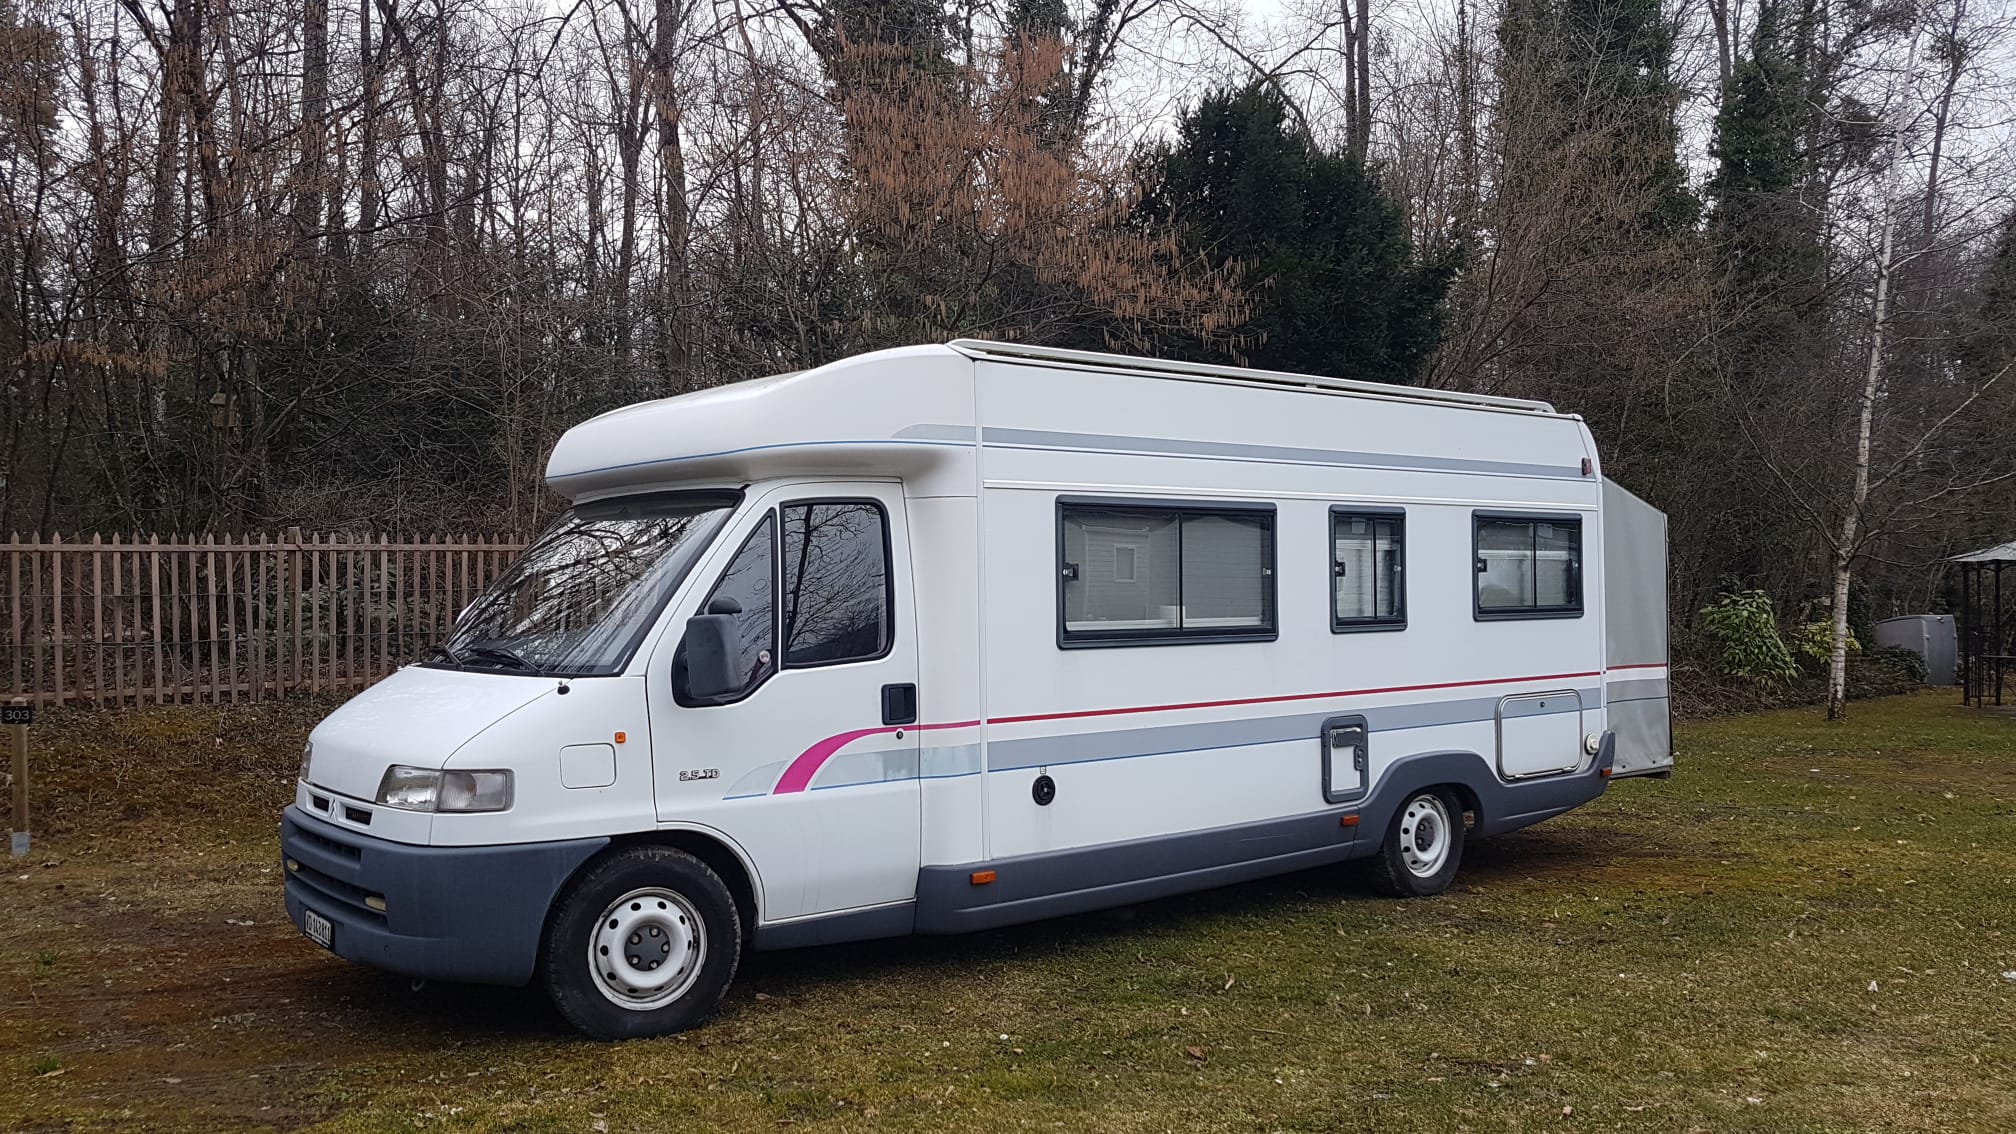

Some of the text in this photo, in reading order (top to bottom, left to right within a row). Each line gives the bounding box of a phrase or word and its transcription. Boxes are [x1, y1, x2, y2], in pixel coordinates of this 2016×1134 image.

[5, 710, 30, 720] 303
[679, 768, 720, 781] 2.5 TD
